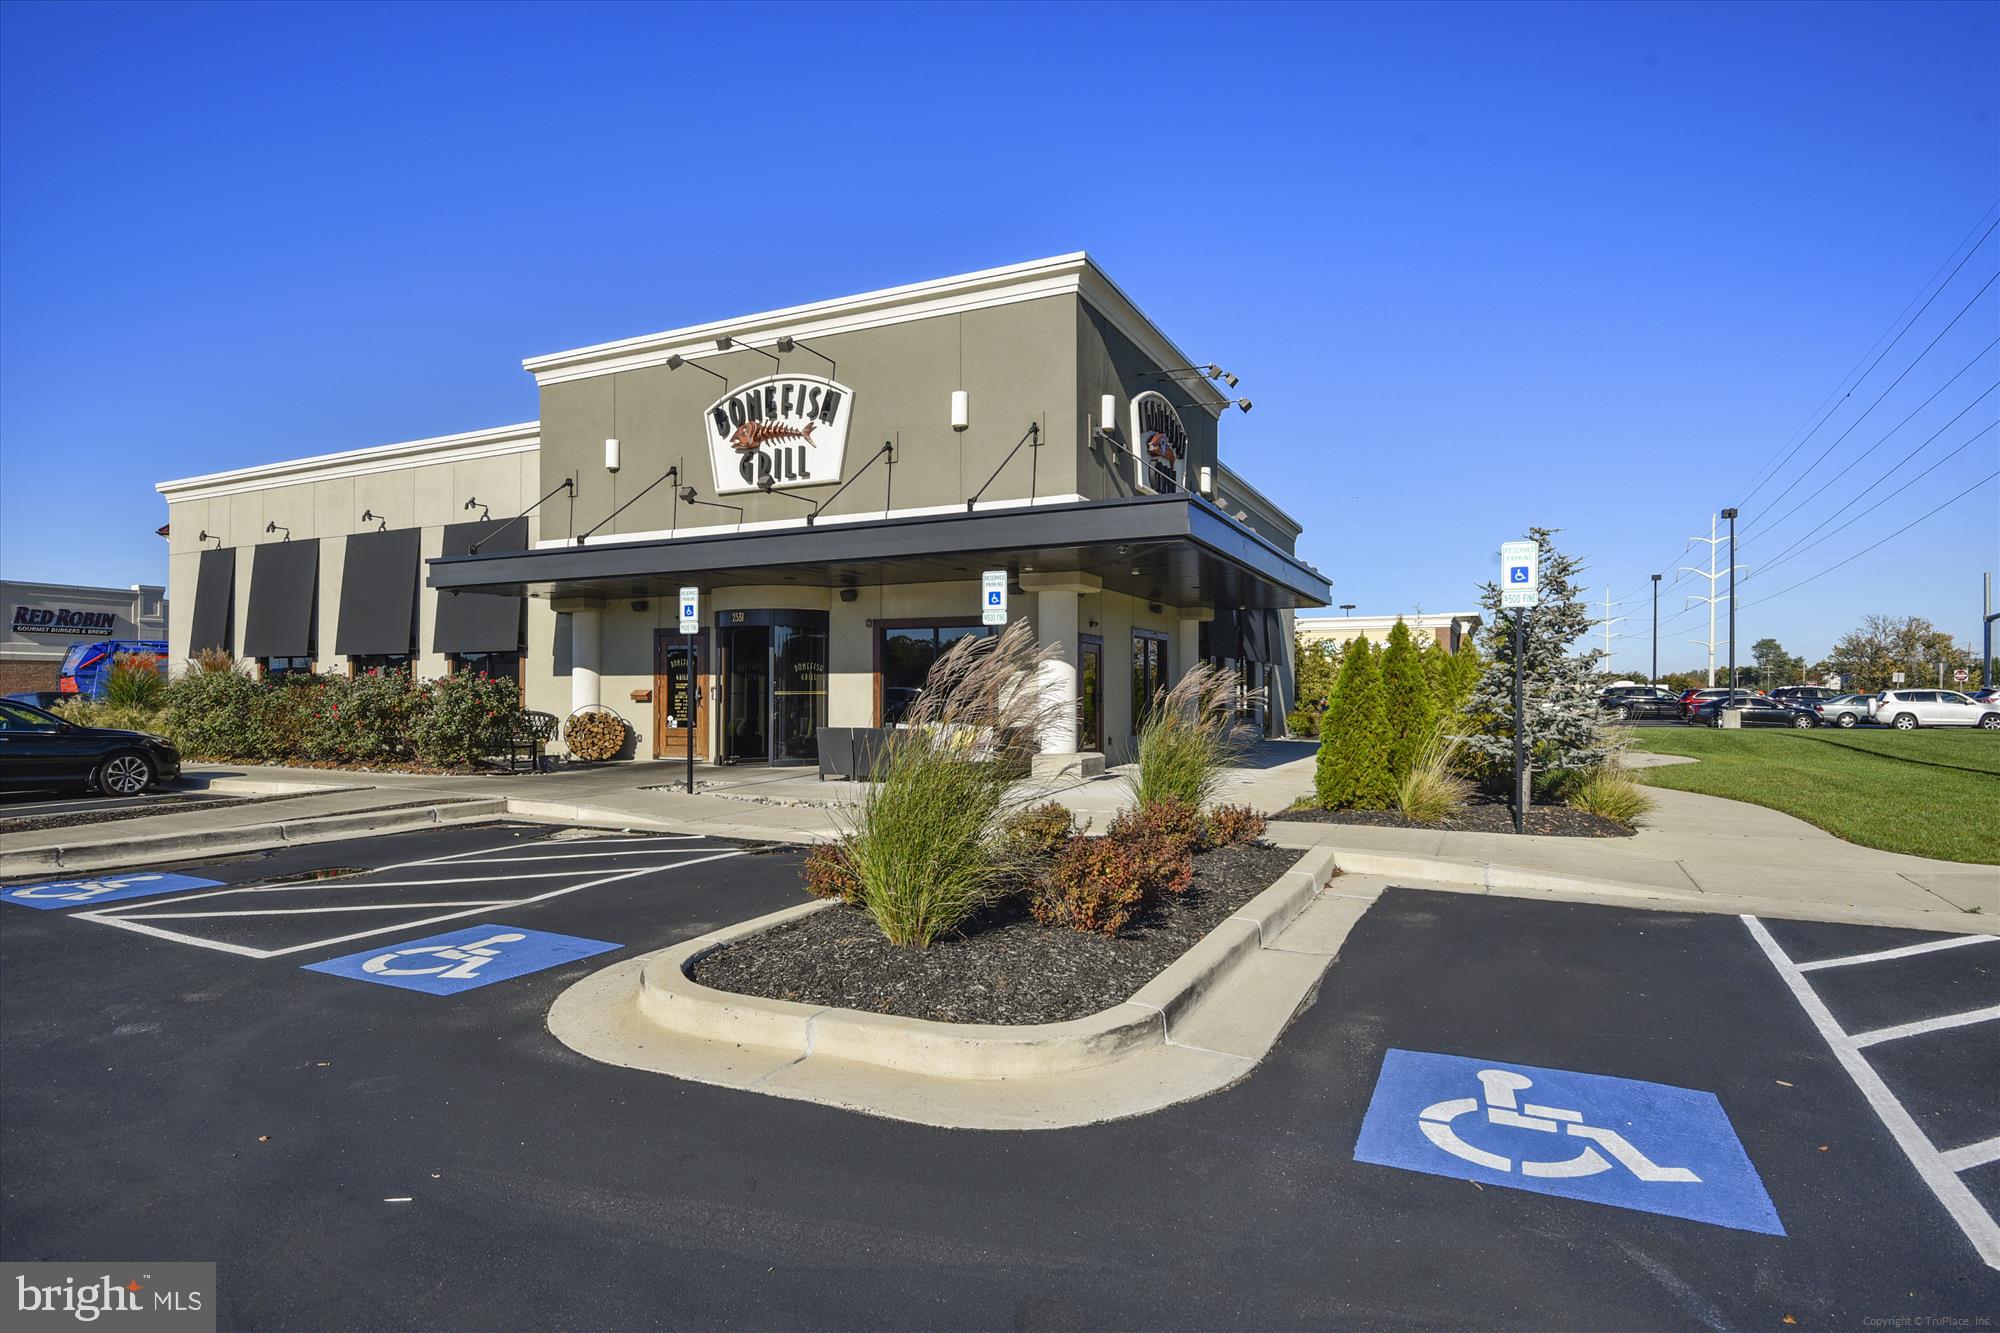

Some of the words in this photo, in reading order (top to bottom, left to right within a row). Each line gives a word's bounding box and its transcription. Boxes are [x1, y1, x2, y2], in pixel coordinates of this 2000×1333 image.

[713, 384, 841, 439] BONEFISH
[739, 445, 811, 485] GRILL
[1522, 593, 1536, 602] FINE
[13, 606, 54, 625] RED
[55, 609, 116, 628] ROBIN
